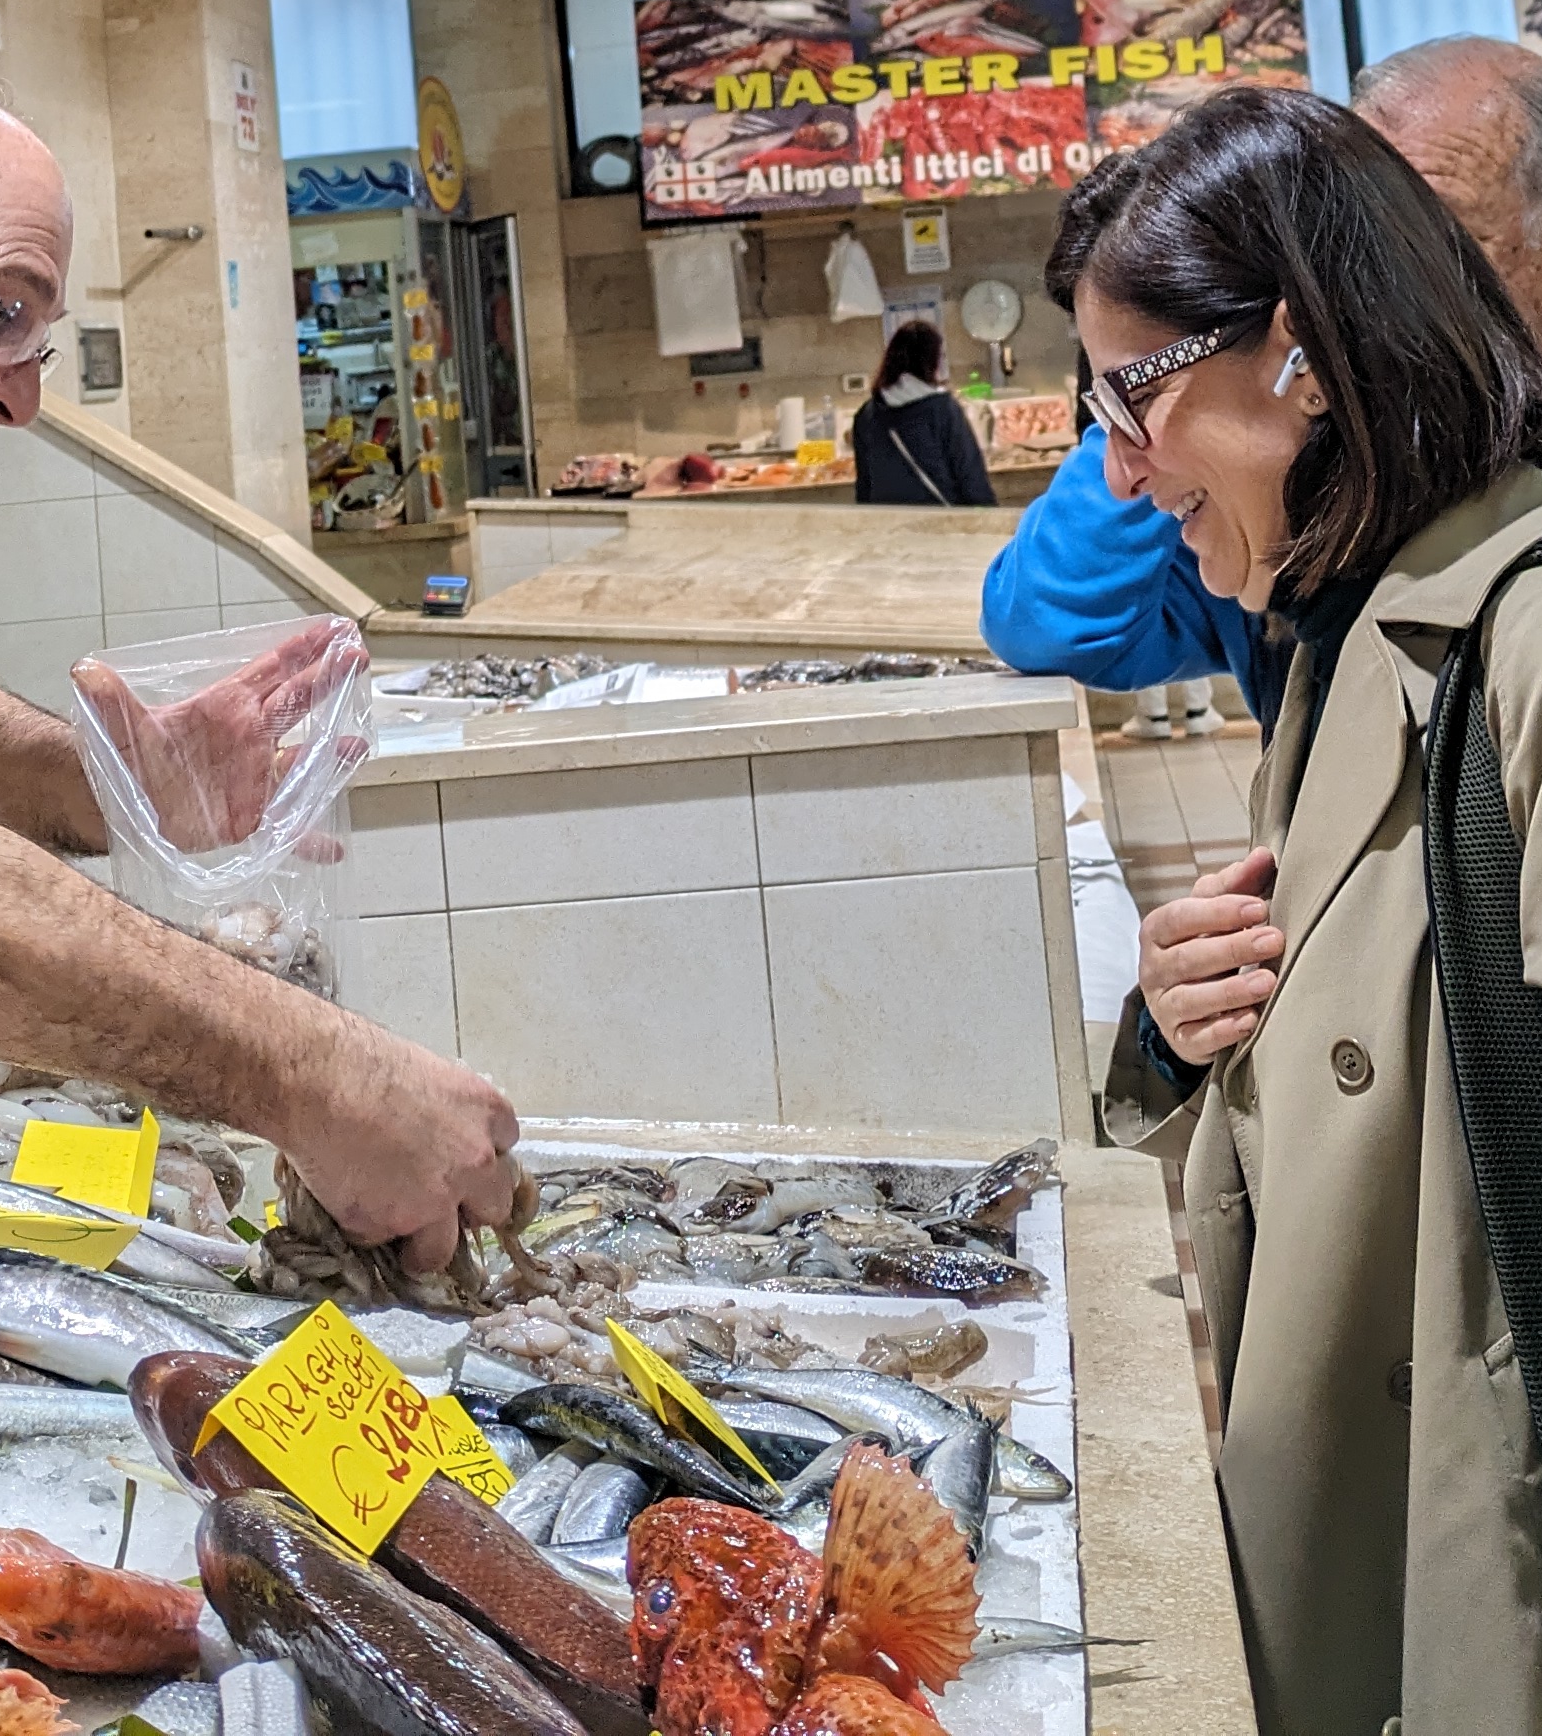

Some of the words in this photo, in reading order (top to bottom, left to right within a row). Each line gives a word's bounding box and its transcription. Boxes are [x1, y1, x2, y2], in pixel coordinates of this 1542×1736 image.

[714, 50, 1021, 113] MASTER
[1049, 33, 1227, 89] FISH
[744, 157, 902, 196] Alimenti
[913, 147, 1005, 182] Ittici
[1017, 144, 1052, 175] di
[234, 1315, 347, 1452] PARAGHI
